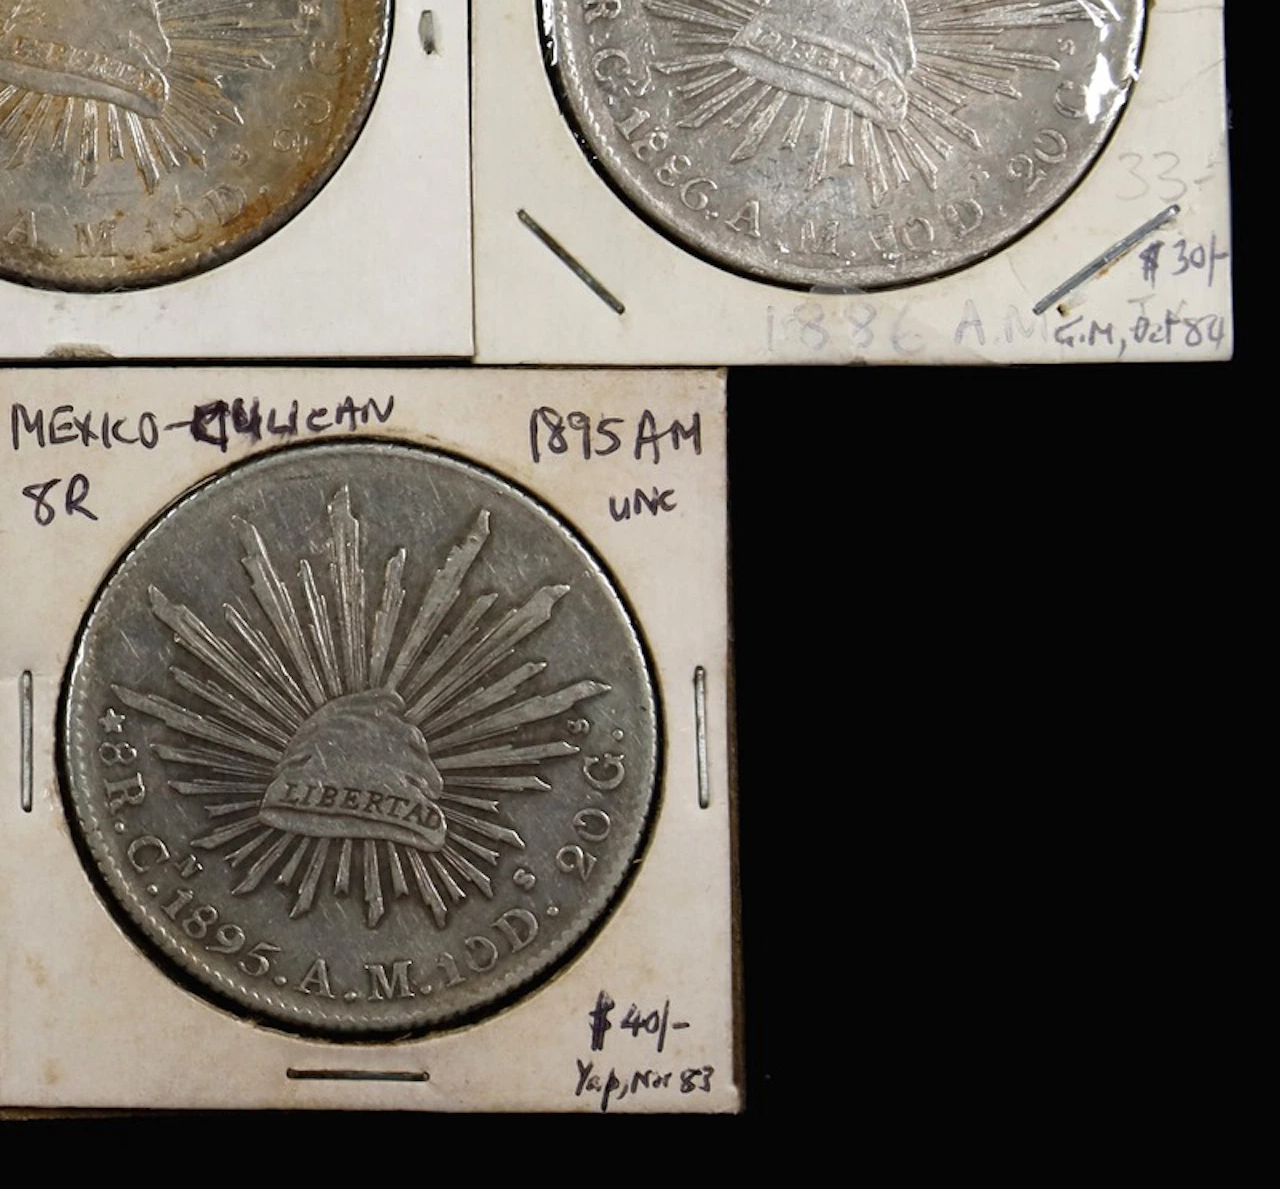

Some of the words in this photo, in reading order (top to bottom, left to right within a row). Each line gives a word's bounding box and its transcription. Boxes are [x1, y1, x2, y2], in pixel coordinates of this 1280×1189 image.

[529, 412, 625, 462] 1895
[631, 415, 703, 462] AM
[25, 474, 99, 526] 8R
[286, 781, 443, 833] LIBERTAD
